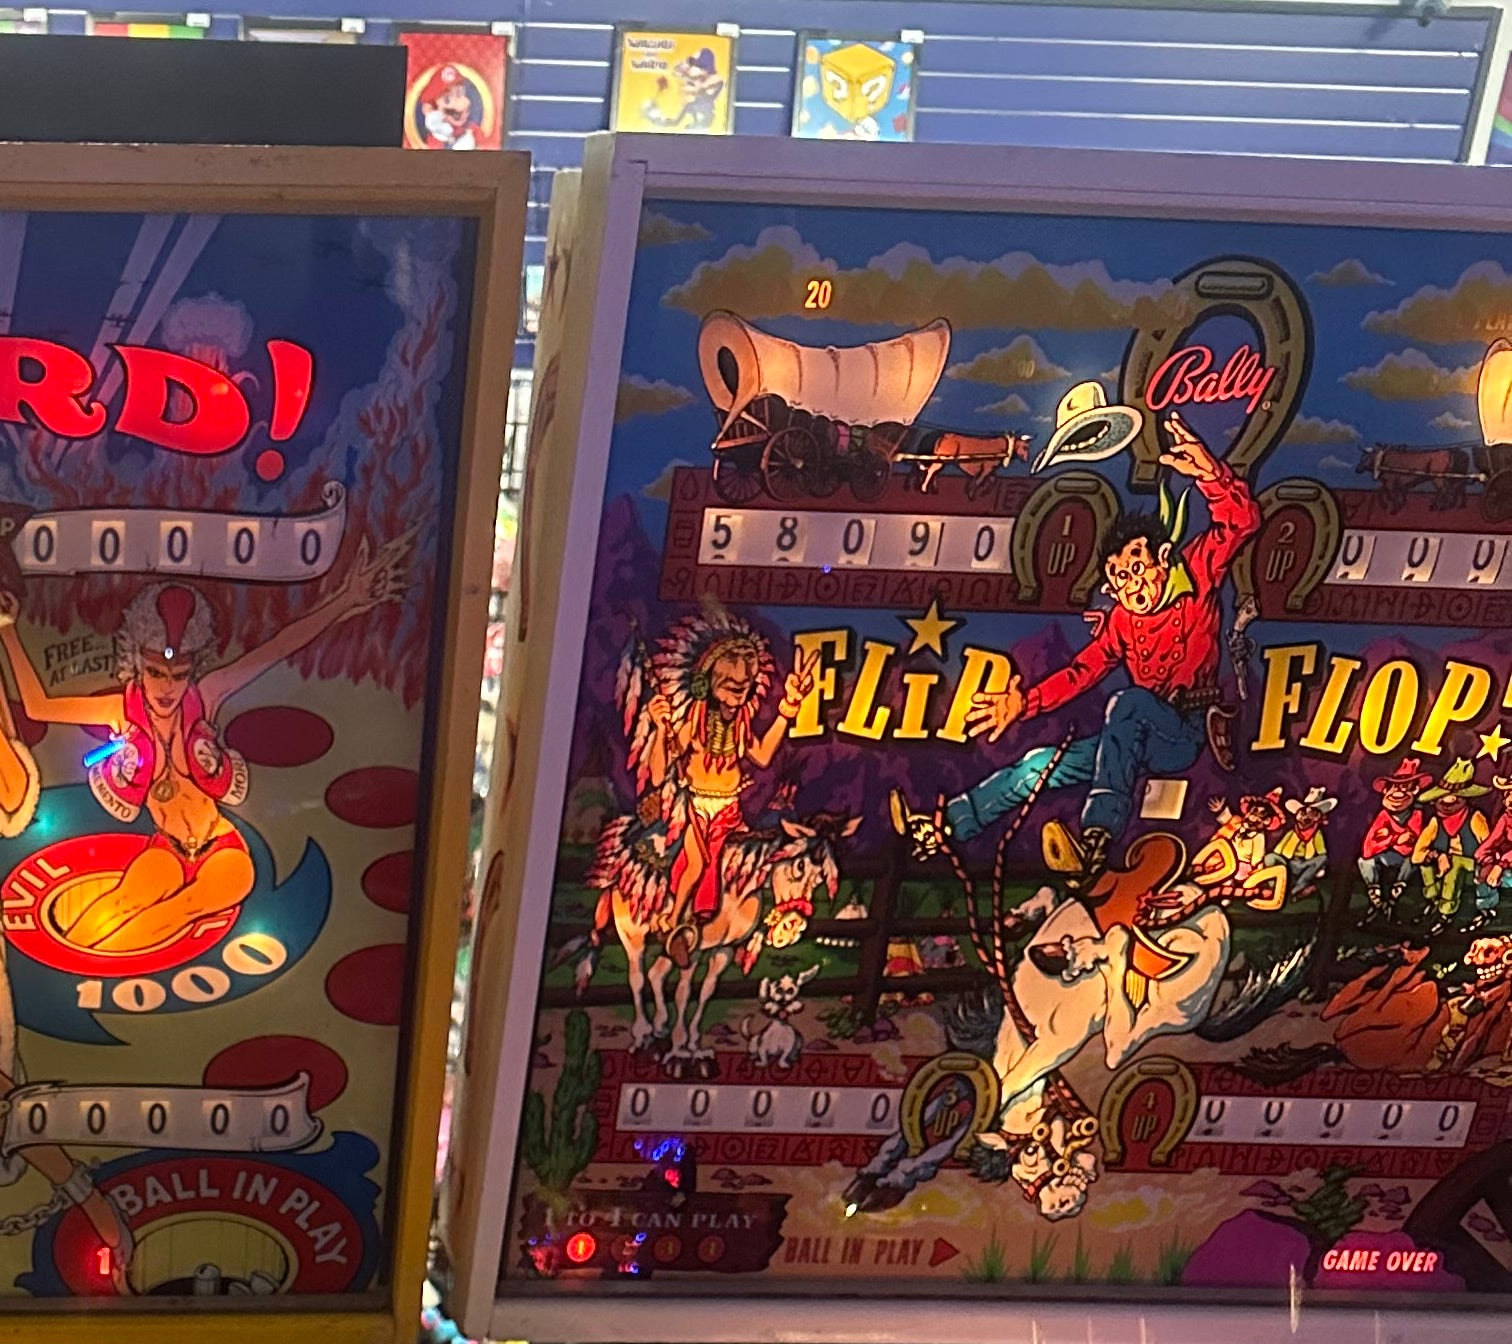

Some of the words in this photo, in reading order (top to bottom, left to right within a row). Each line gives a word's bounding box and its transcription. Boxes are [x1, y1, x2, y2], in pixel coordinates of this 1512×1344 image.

[804, 280, 832, 309] 20
[1145, 344, 1276, 414] Bally
[1047, 544, 1076, 577] UP
[1265, 550, 1295, 583] UP
[789, 627, 1012, 744] FLIP
[2, 855, 72, 932] EVIL
[76, 932, 289, 1013] 1000
[933, 1109, 960, 1138] UP
[1131, 1115, 1158, 1144] UP
[109, 1167, 221, 1216] BALL
[232, 1170, 280, 1206] IN
[278, 1187, 348, 1265] PLAY
[631, 1212, 681, 1229] CAN
[691, 1213, 757, 1230] PLAY
[96, 1246, 111, 1276] 1
[783, 1236, 832, 1265] BALL
[839, 1237, 866, 1266] IN
[873, 1238, 925, 1266] PLAY
[1322, 1249, 1380, 1272] GAME
[1386, 1250, 1440, 1273] OVER
